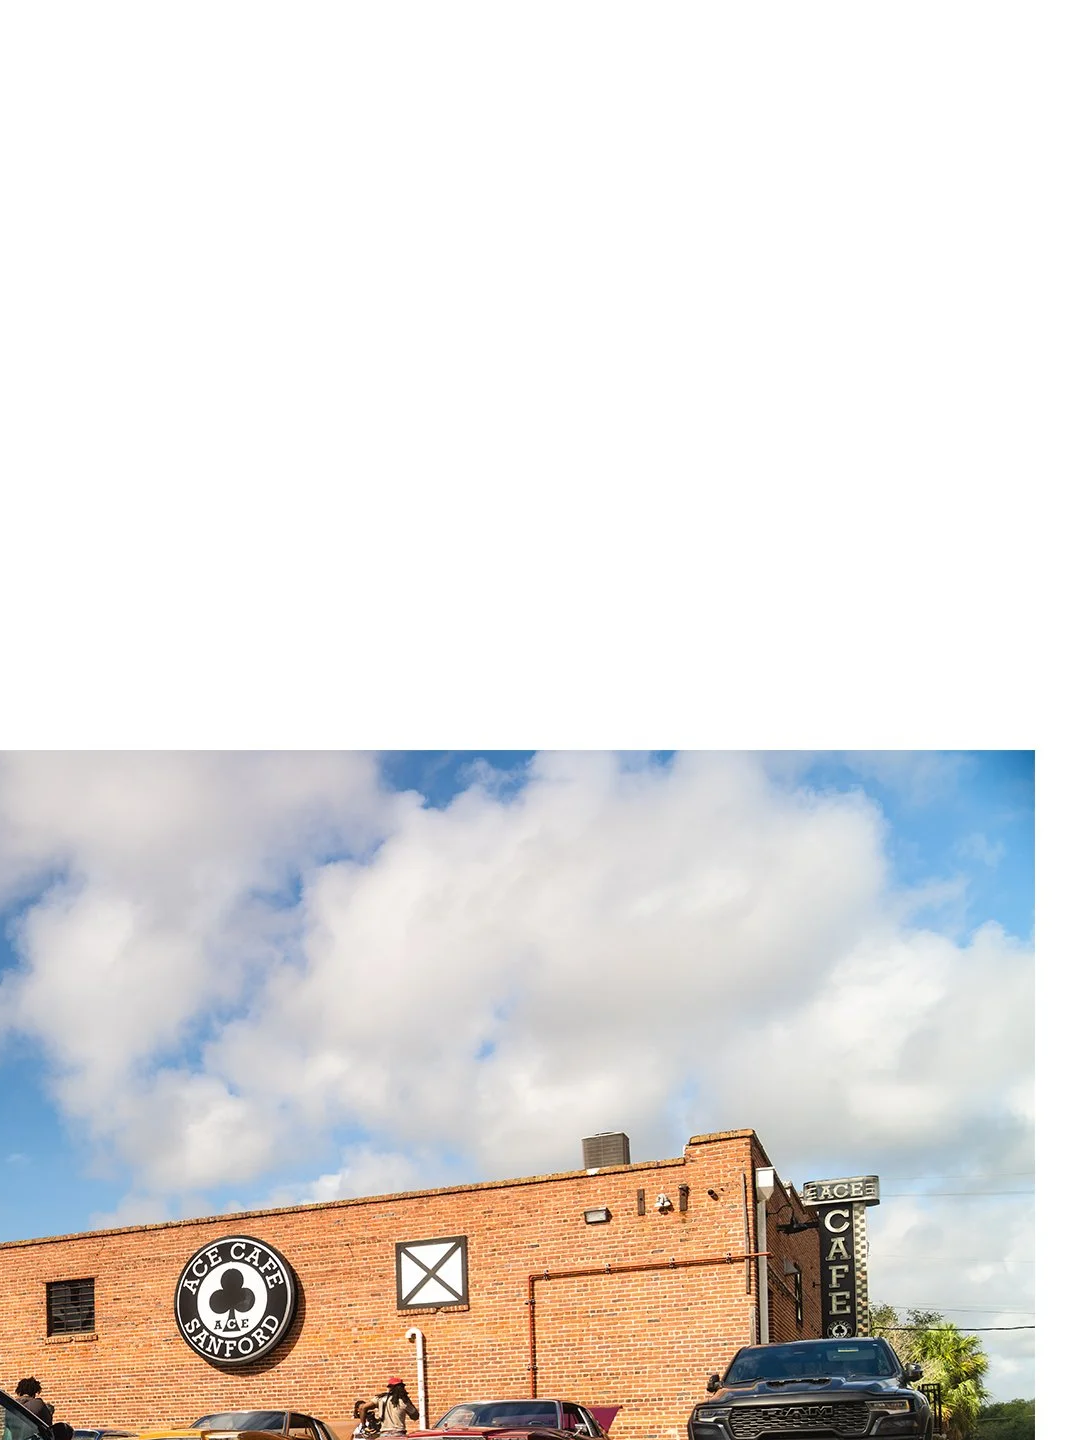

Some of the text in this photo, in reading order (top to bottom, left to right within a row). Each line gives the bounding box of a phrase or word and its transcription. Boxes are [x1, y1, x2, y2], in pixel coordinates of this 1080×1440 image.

[820, 1182, 863, 1200] ACE
[183, 1242, 284, 1295] ACE CAFE
[824, 1208, 852, 1316] CAFE
[184, 1315, 279, 1358] SANFORD
[214, 1318, 249, 1330] ACE
[761, 1405, 833, 1418] RAM
